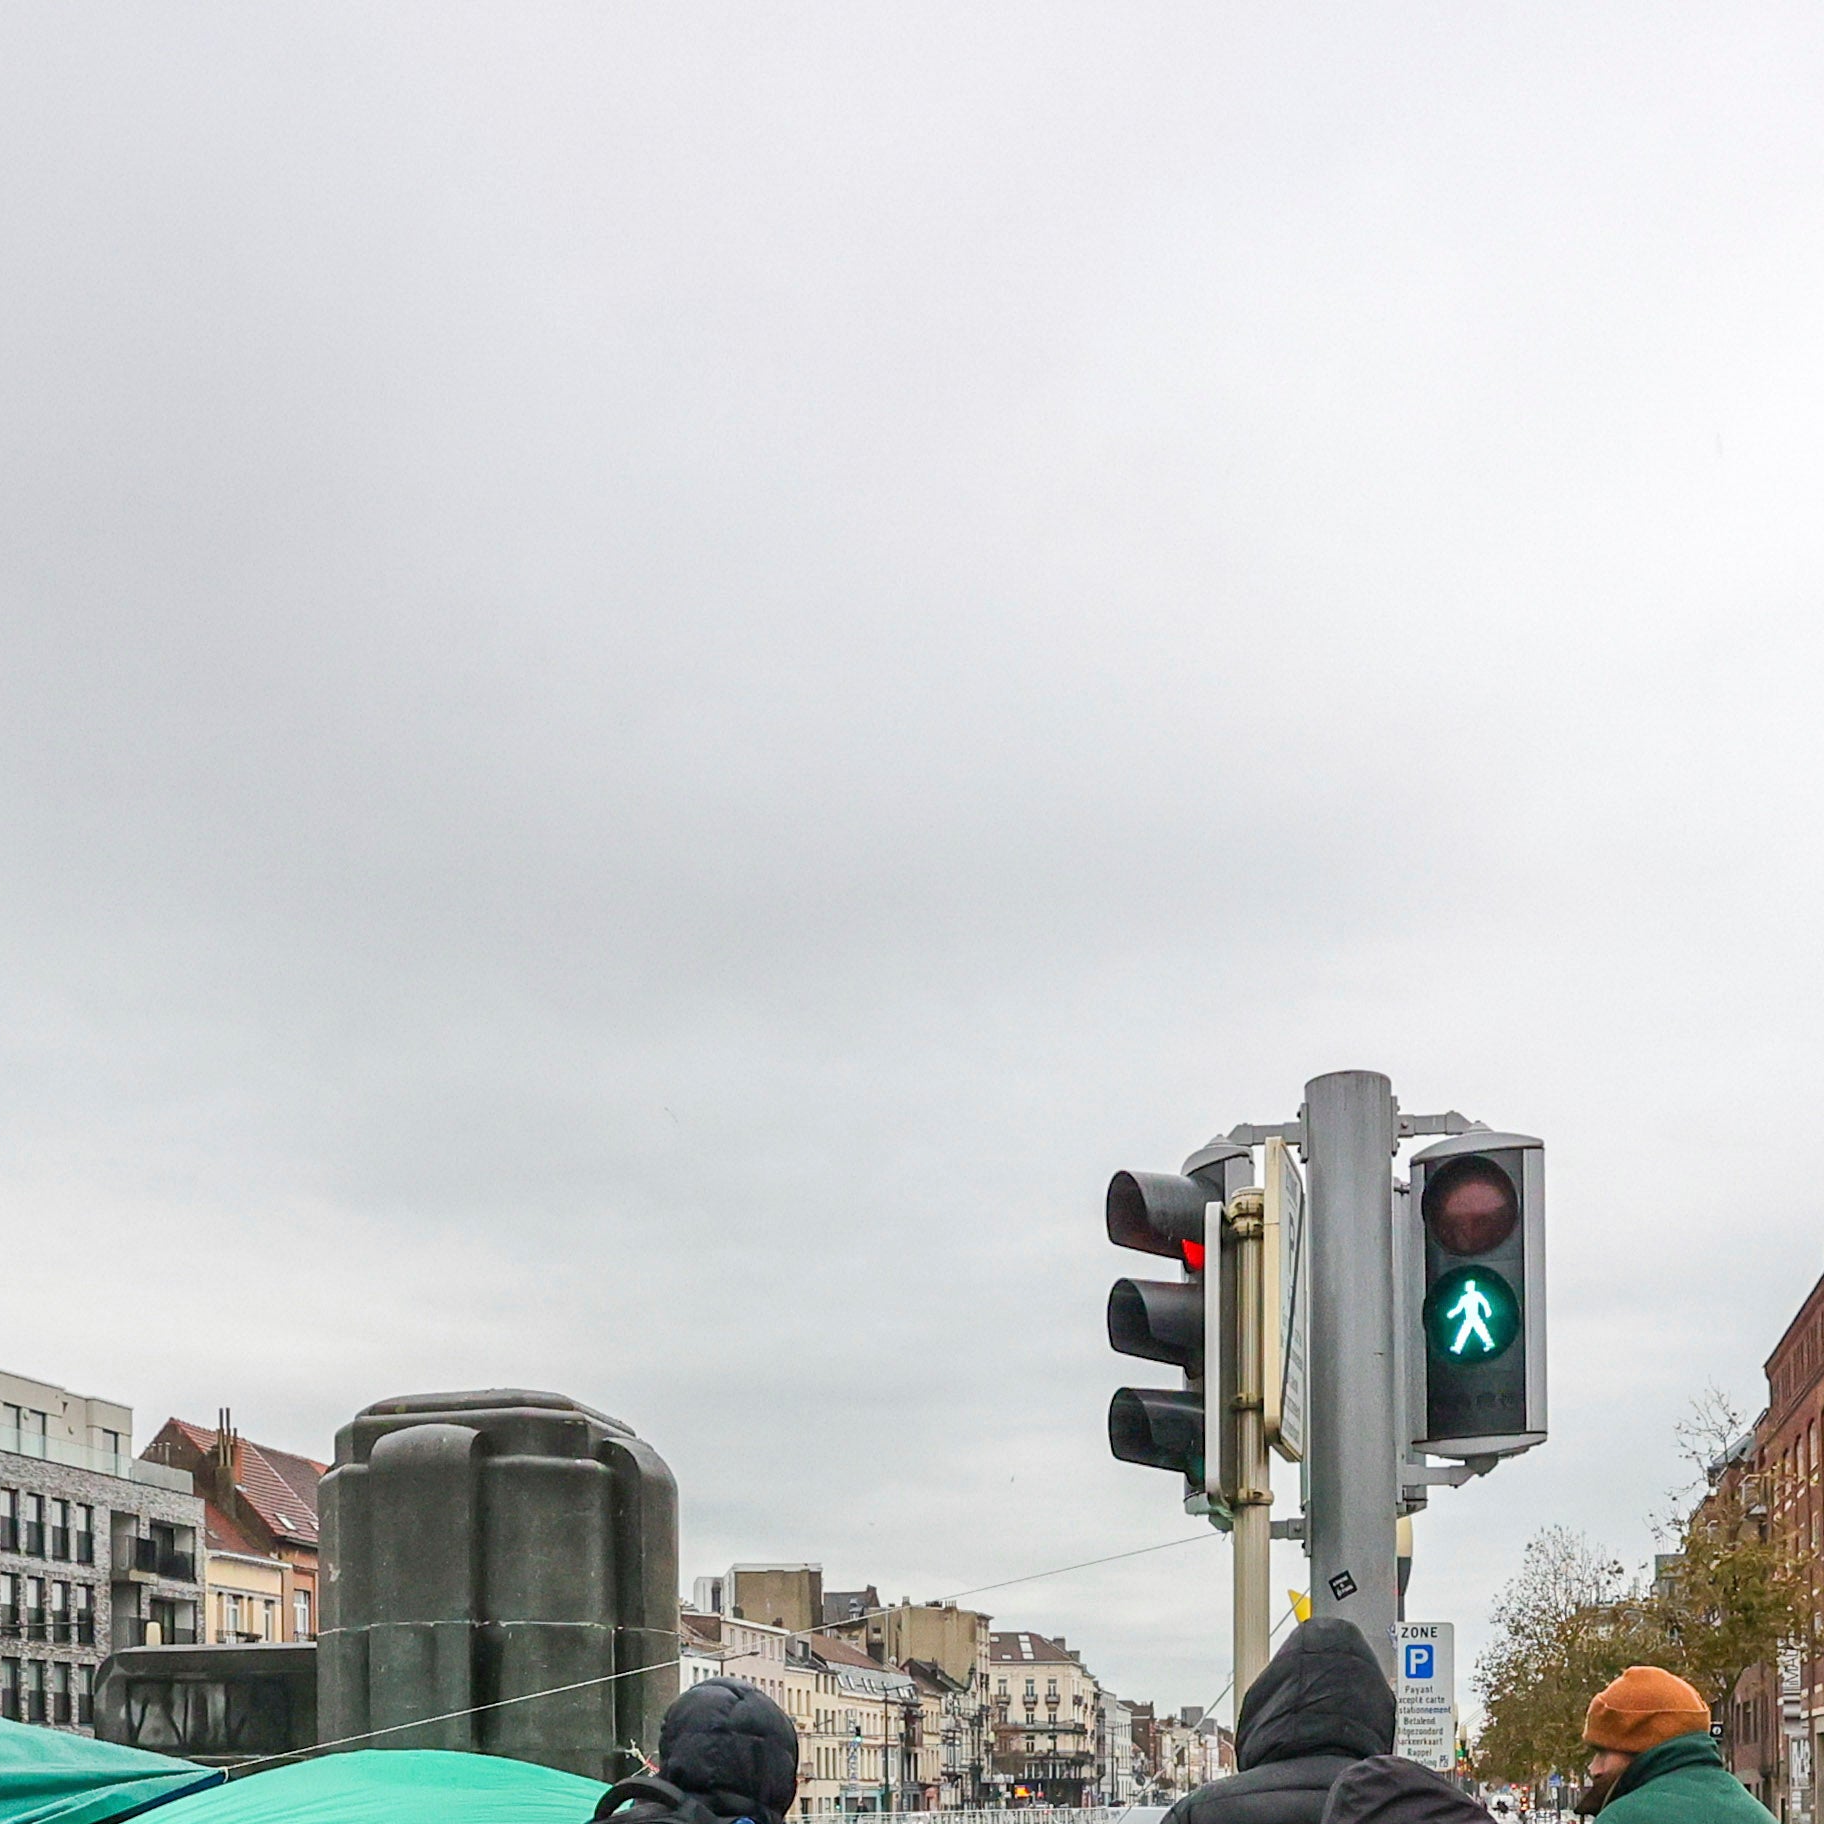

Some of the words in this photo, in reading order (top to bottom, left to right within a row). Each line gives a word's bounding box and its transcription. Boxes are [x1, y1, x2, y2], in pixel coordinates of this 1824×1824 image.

[1401, 1626, 1438, 1638] ZONE
[1410, 1648, 1429, 1675] P
[1405, 1684, 1433, 1695] Payant
[1425, 1696, 1445, 1704] carte
[1404, 1716, 1436, 1726] Betalend
[1407, 1747, 1432, 1757] Rappel
